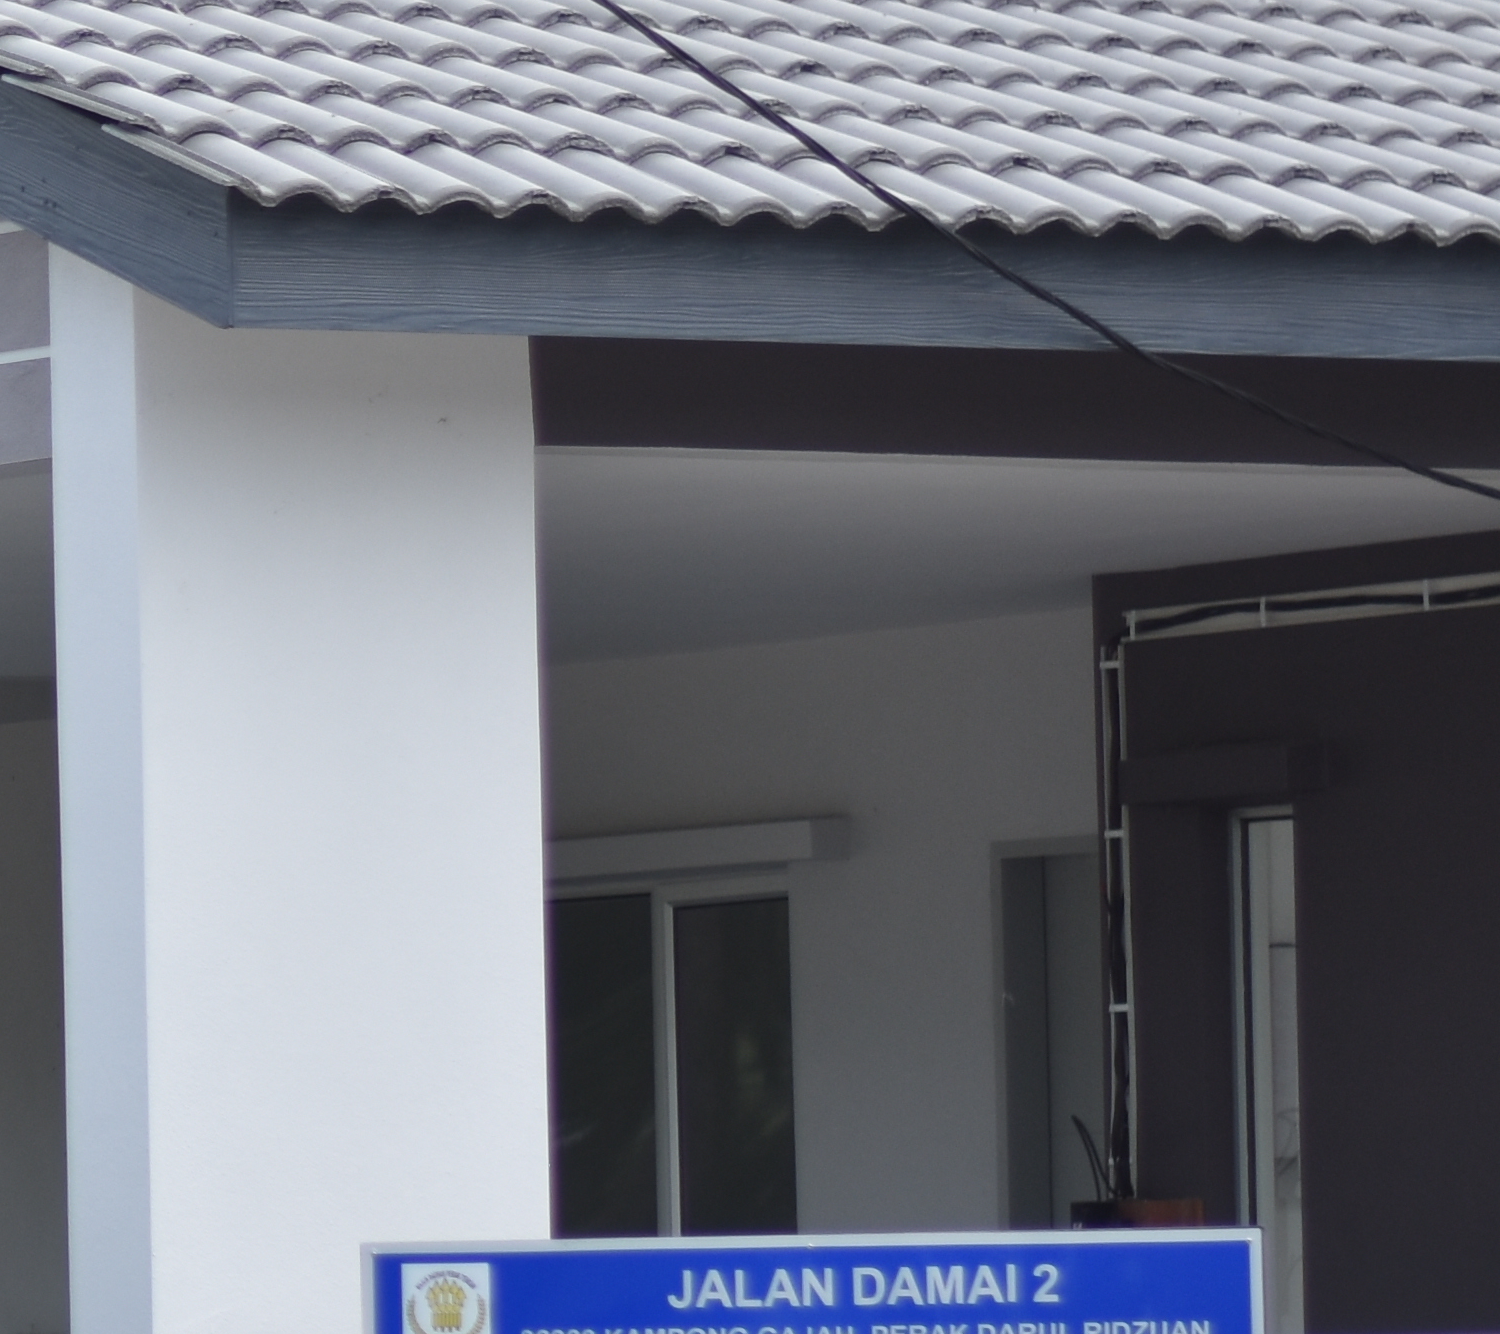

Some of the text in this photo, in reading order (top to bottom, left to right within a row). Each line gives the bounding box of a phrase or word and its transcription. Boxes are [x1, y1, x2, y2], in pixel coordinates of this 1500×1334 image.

[667, 1263, 1060, 1309] JALAN DAMAI 2
